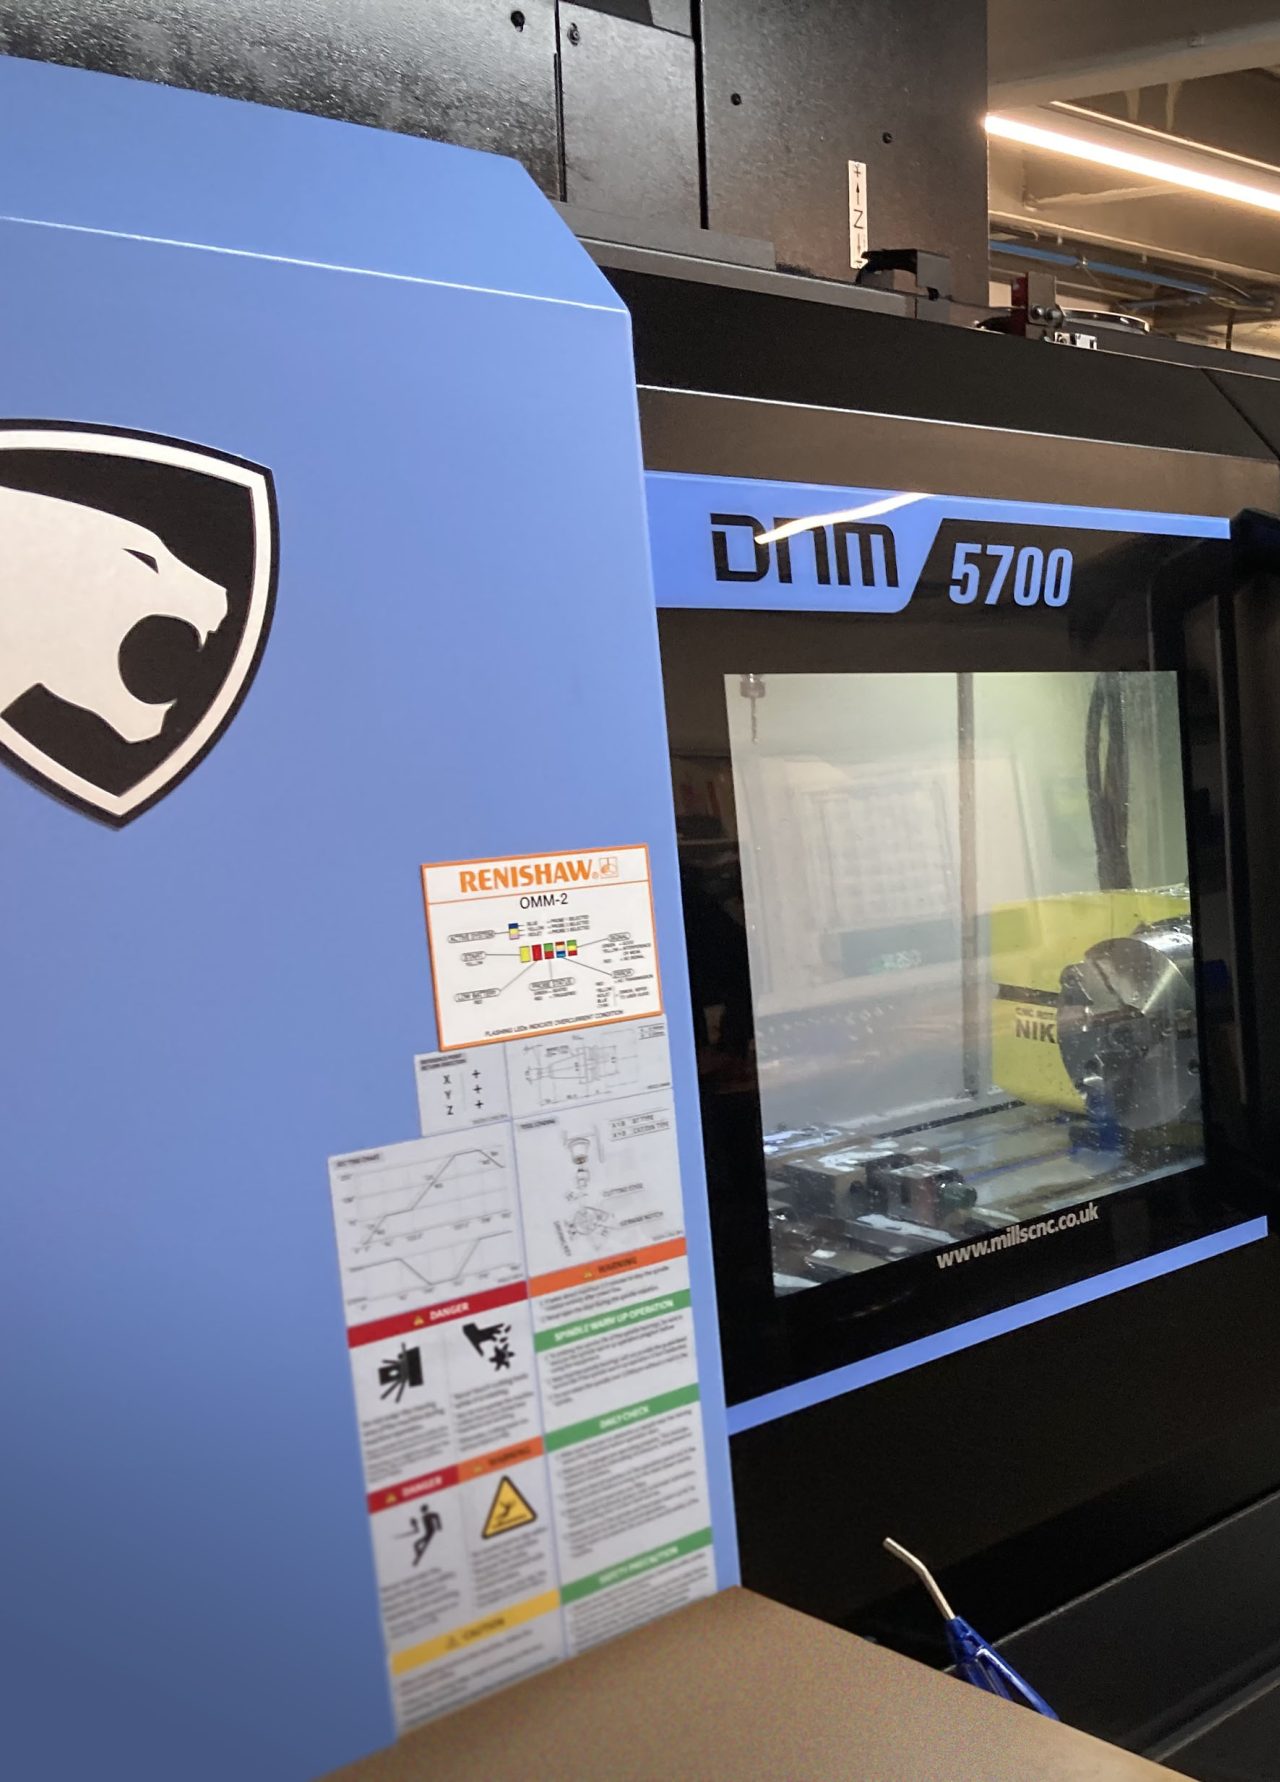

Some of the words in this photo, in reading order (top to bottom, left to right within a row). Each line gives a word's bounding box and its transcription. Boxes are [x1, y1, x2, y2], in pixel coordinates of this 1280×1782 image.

[853, 208, 864, 229] Z
[949, 542, 1074, 607] 5700
[460, 858, 593, 893] RENISHAW
[520, 893, 568, 909] OMM-2
[1015, 1019, 1056, 1044] NIK
[443, 1074, 451, 1085] X
[444, 1090, 452, 1100] Y
[446, 1105, 454, 1116] Z
[936, 1202, 1099, 1269] www.millscnc.co.uk
[429, 1302, 470, 1321] DANGER
[402, 1476, 442, 1497] DANGER
